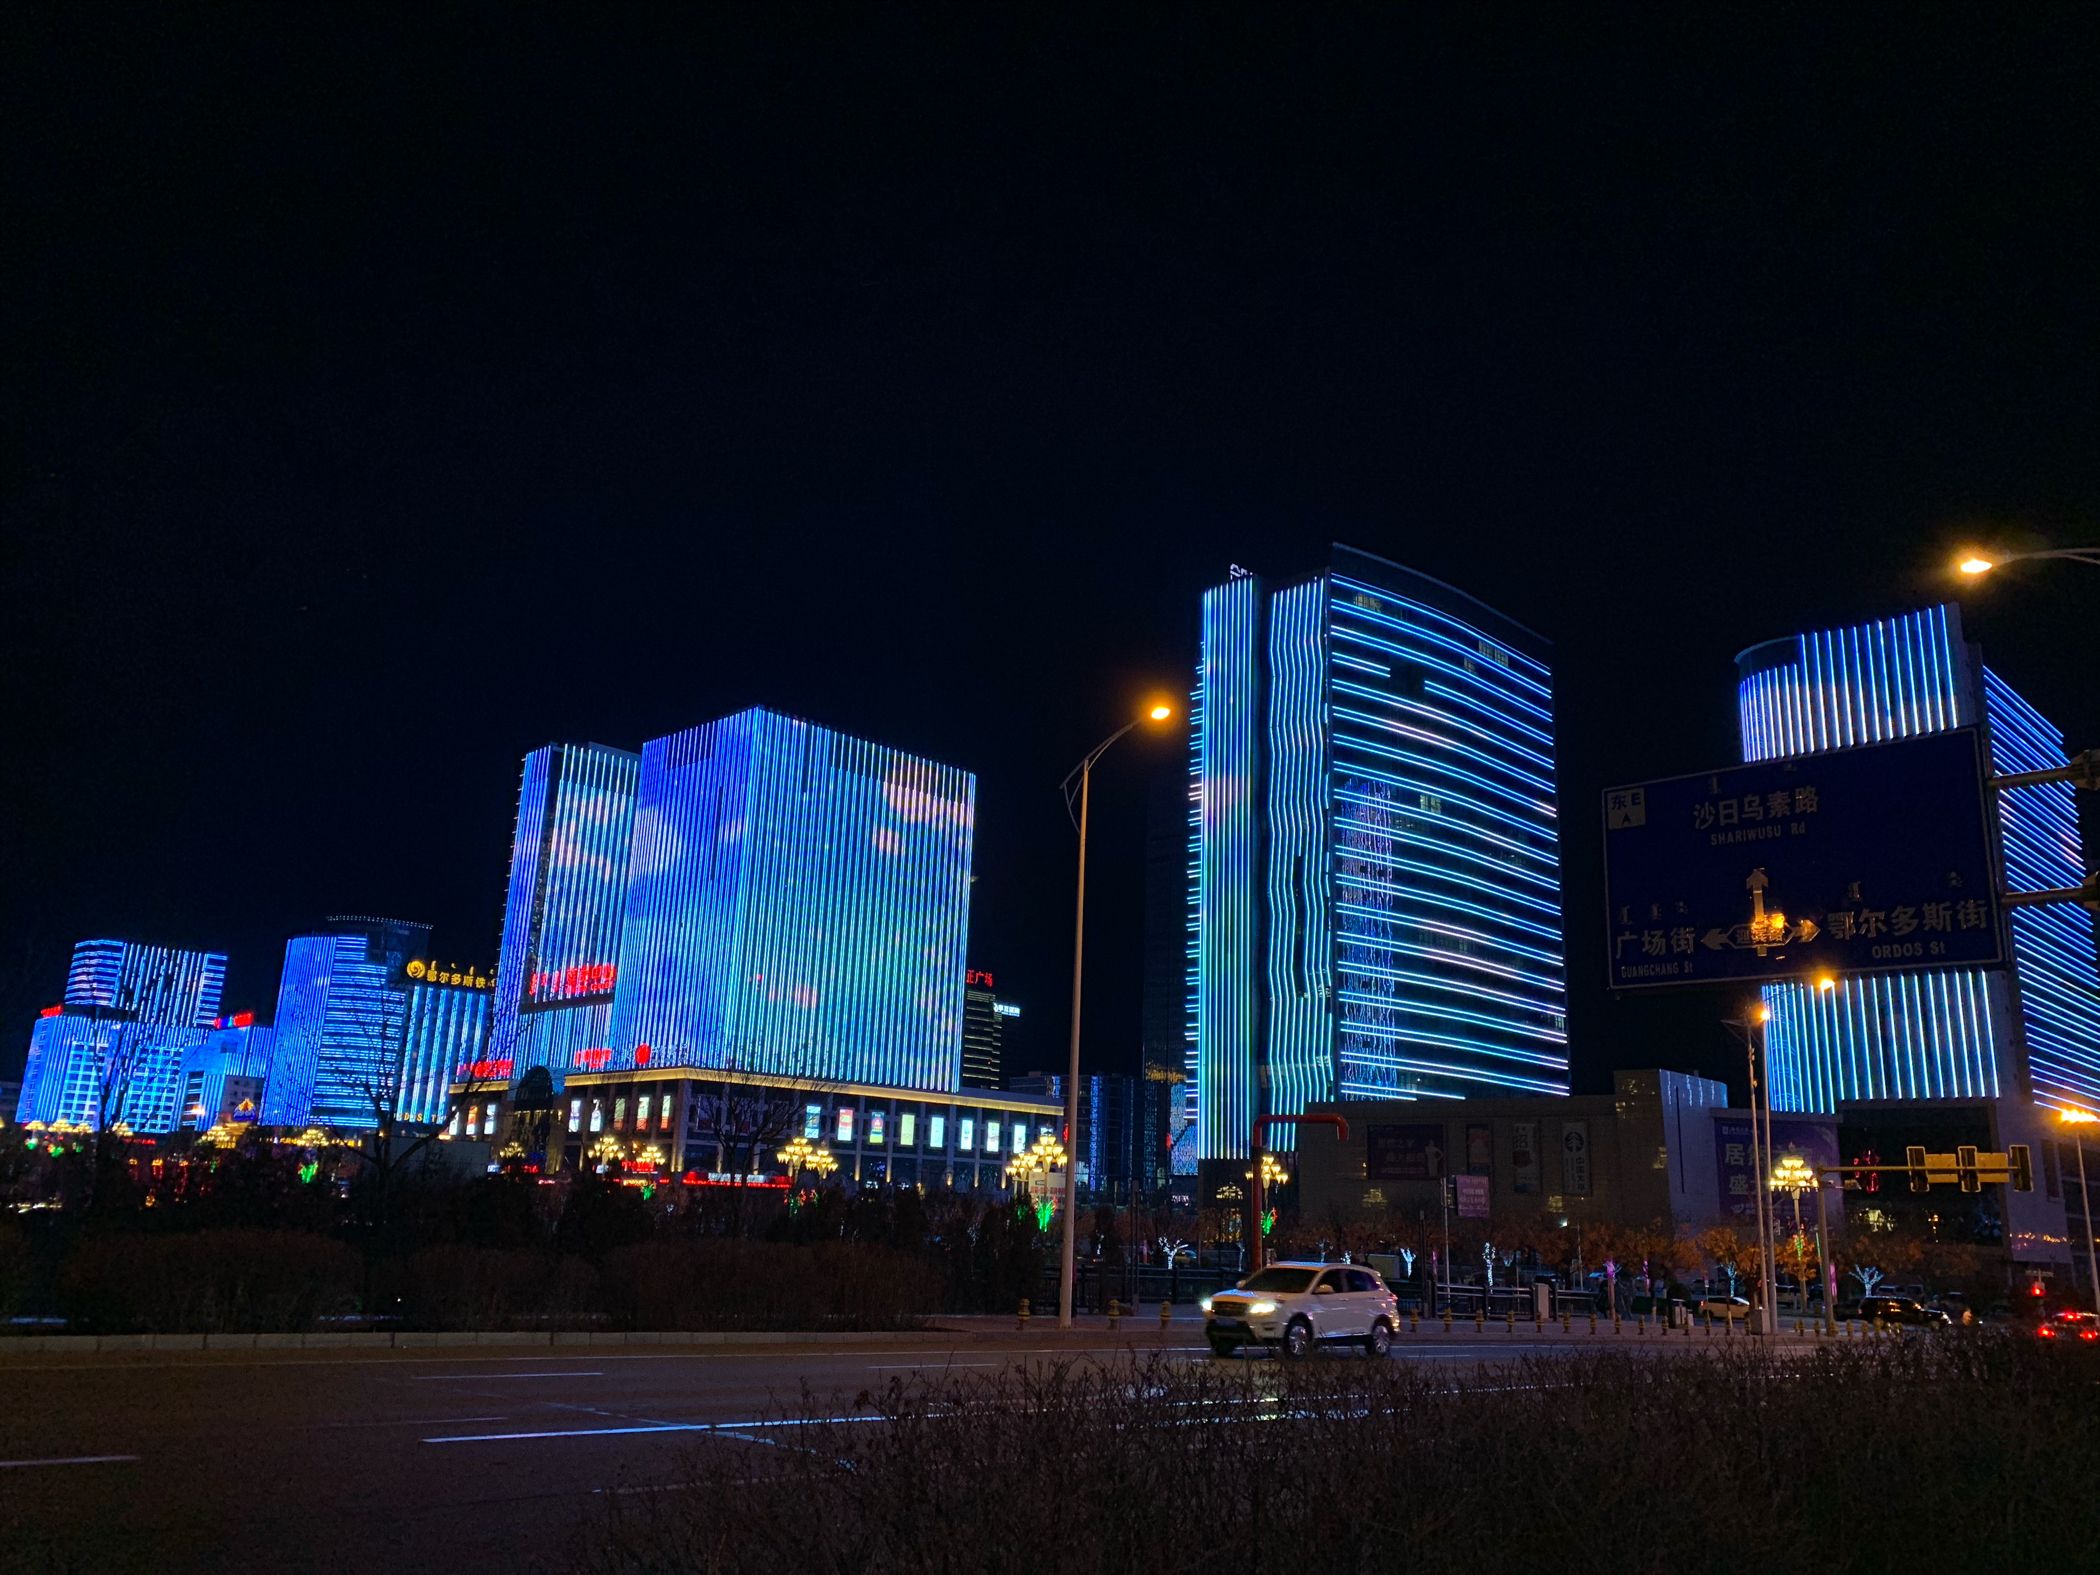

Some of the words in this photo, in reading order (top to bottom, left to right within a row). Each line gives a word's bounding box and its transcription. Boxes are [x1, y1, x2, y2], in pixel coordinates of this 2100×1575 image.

[1611, 795, 1627, 810] 东
[1631, 792, 1641, 806] E
[1693, 785, 1819, 830] 沙日乌素路
[1710, 825, 1782, 846] SHARIWUSU
[1790, 821, 1806, 836] Rd
[1827, 898, 1988, 941] 鄂尔多斯街
[1616, 927, 1696, 960] 广场街
[1872, 943, 1924, 959] ORDOS
[1929, 940, 1946, 955] St
[1620, 962, 1680, 979] GUANGCHANG
[1683, 960, 1694, 975] St
